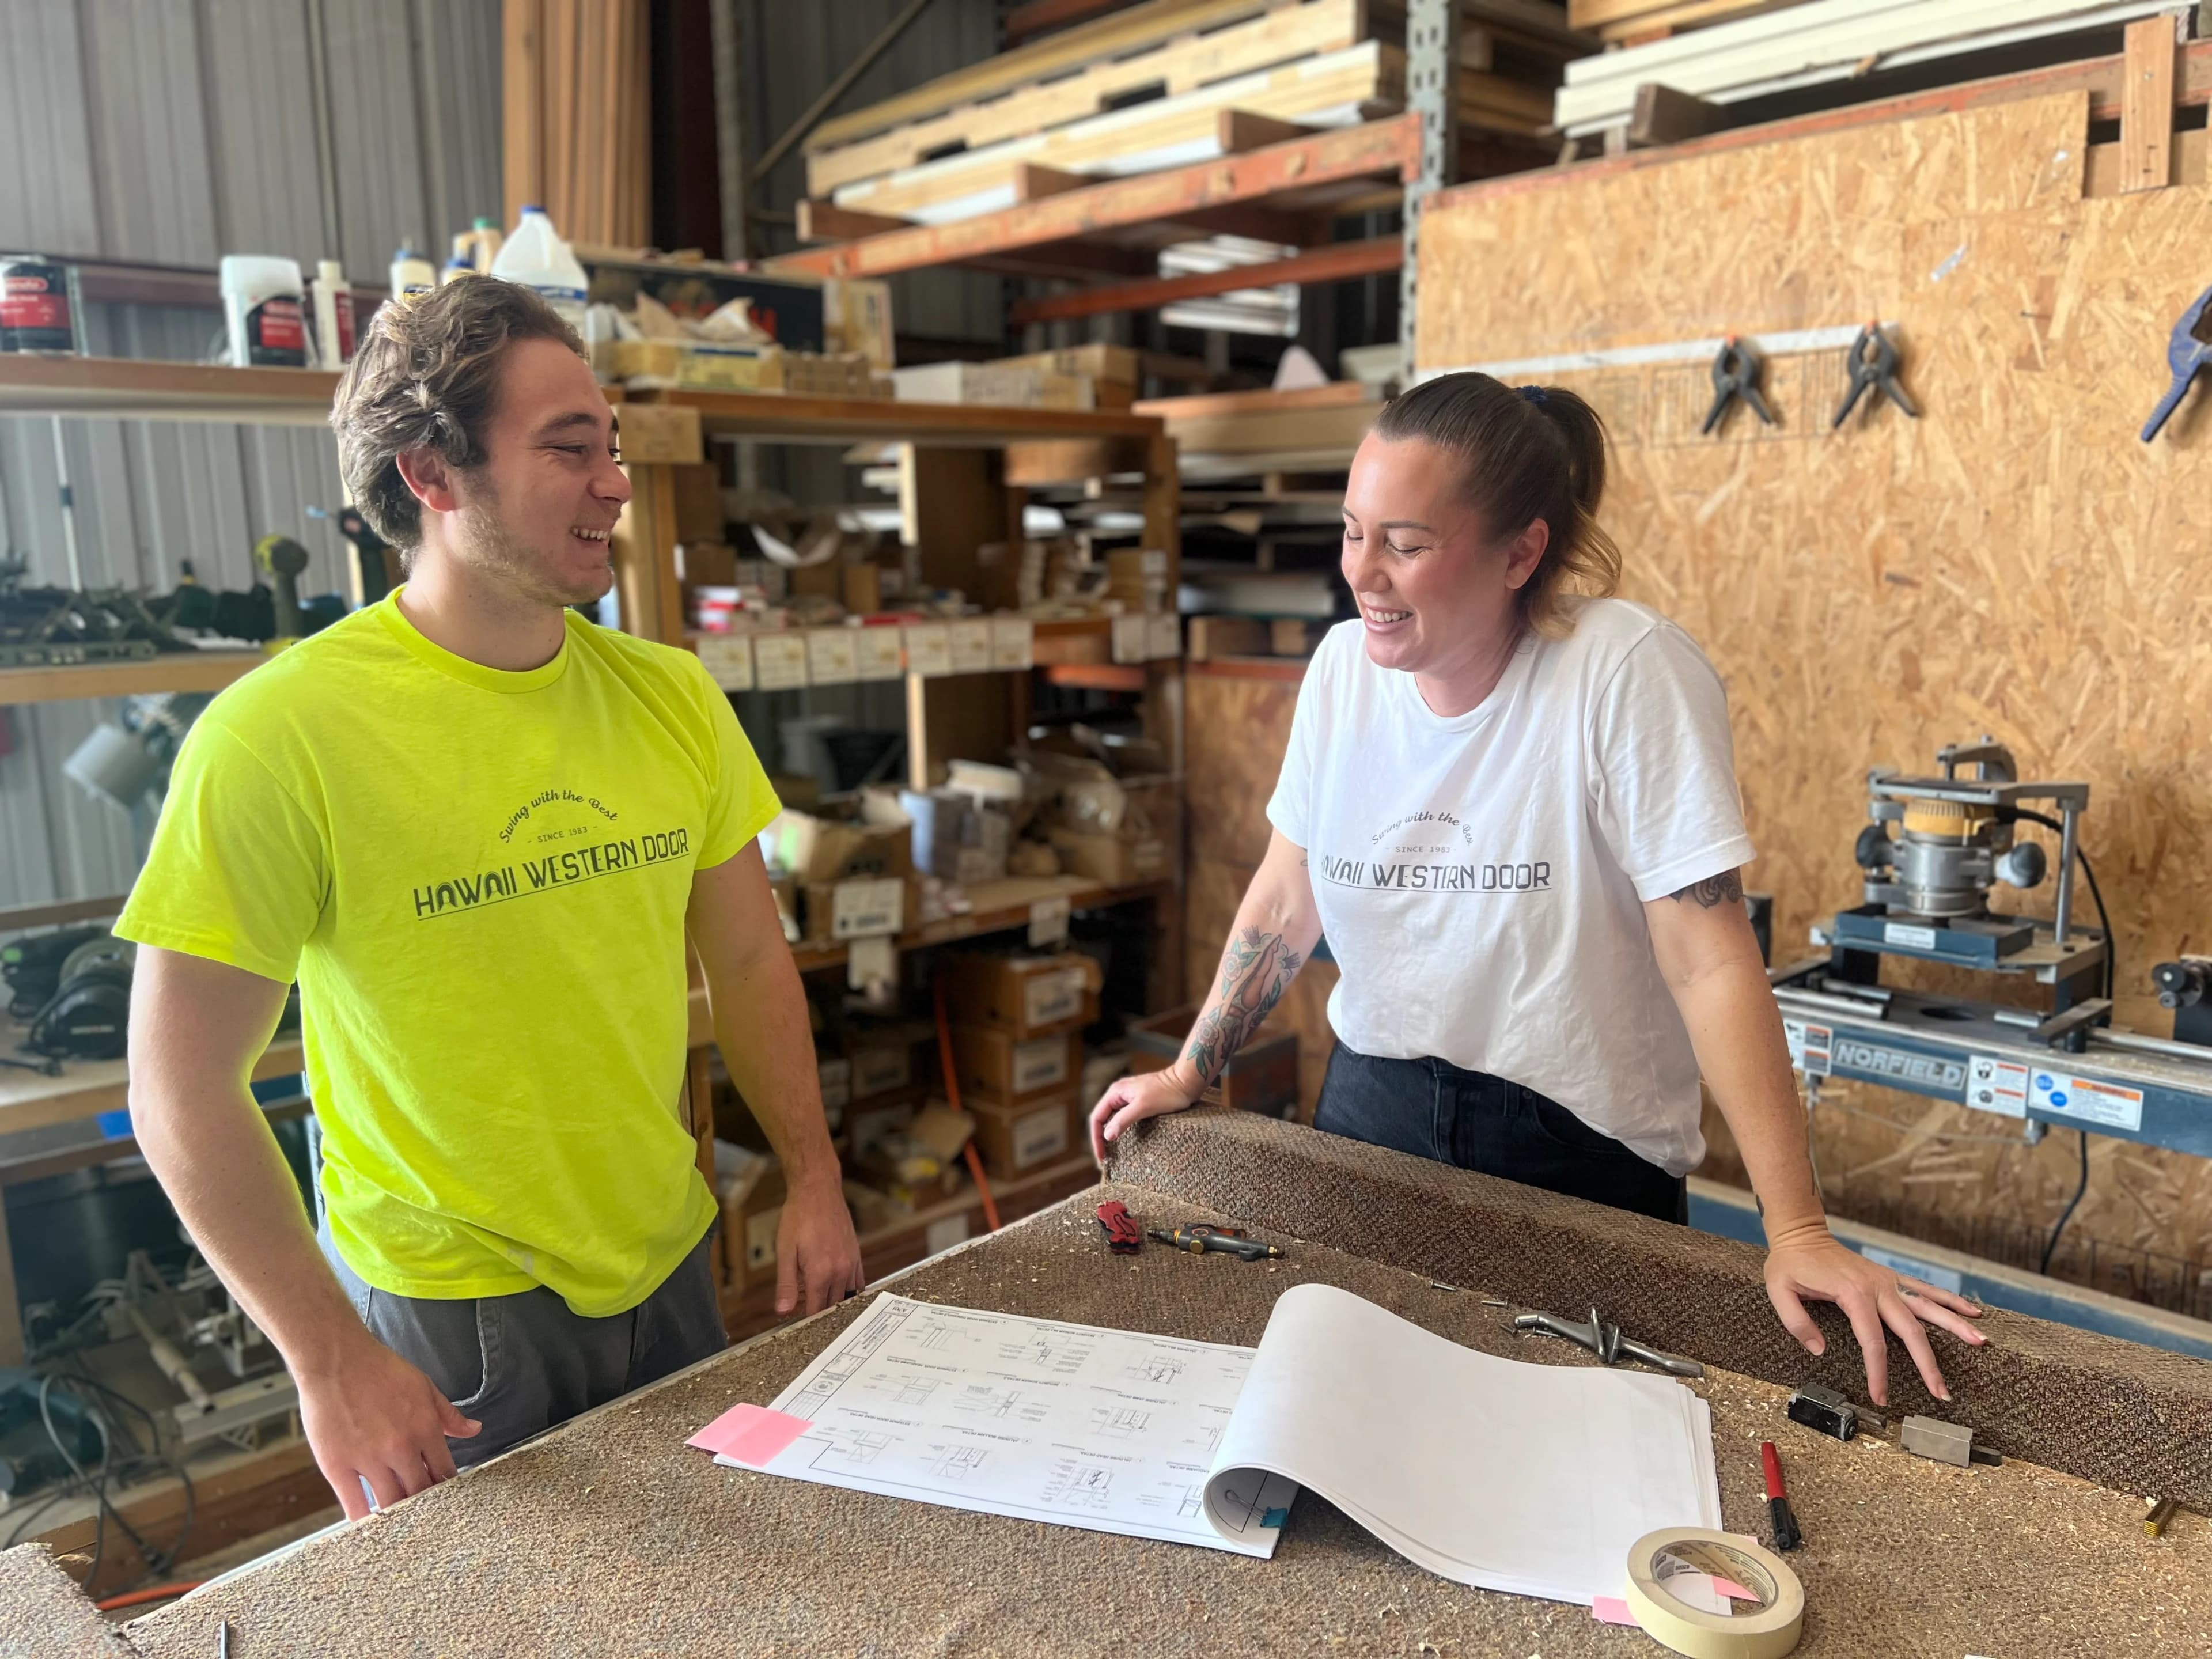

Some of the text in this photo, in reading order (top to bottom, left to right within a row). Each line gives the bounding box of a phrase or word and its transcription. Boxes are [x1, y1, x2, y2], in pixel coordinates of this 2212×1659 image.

[499, 789, 618, 843] Swing with the Best
[537, 826, 588, 843] SINCE 1983
[1404, 811, 1435, 823] with
[1437, 812, 1461, 826] the
[413, 828, 690, 916] HAWAII WESTERN DOOR
[1321, 855, 1365, 885] AWAII
[1482, 862, 1550, 889] DOOR
[1836, 1044, 1960, 1084] NORFIELD
